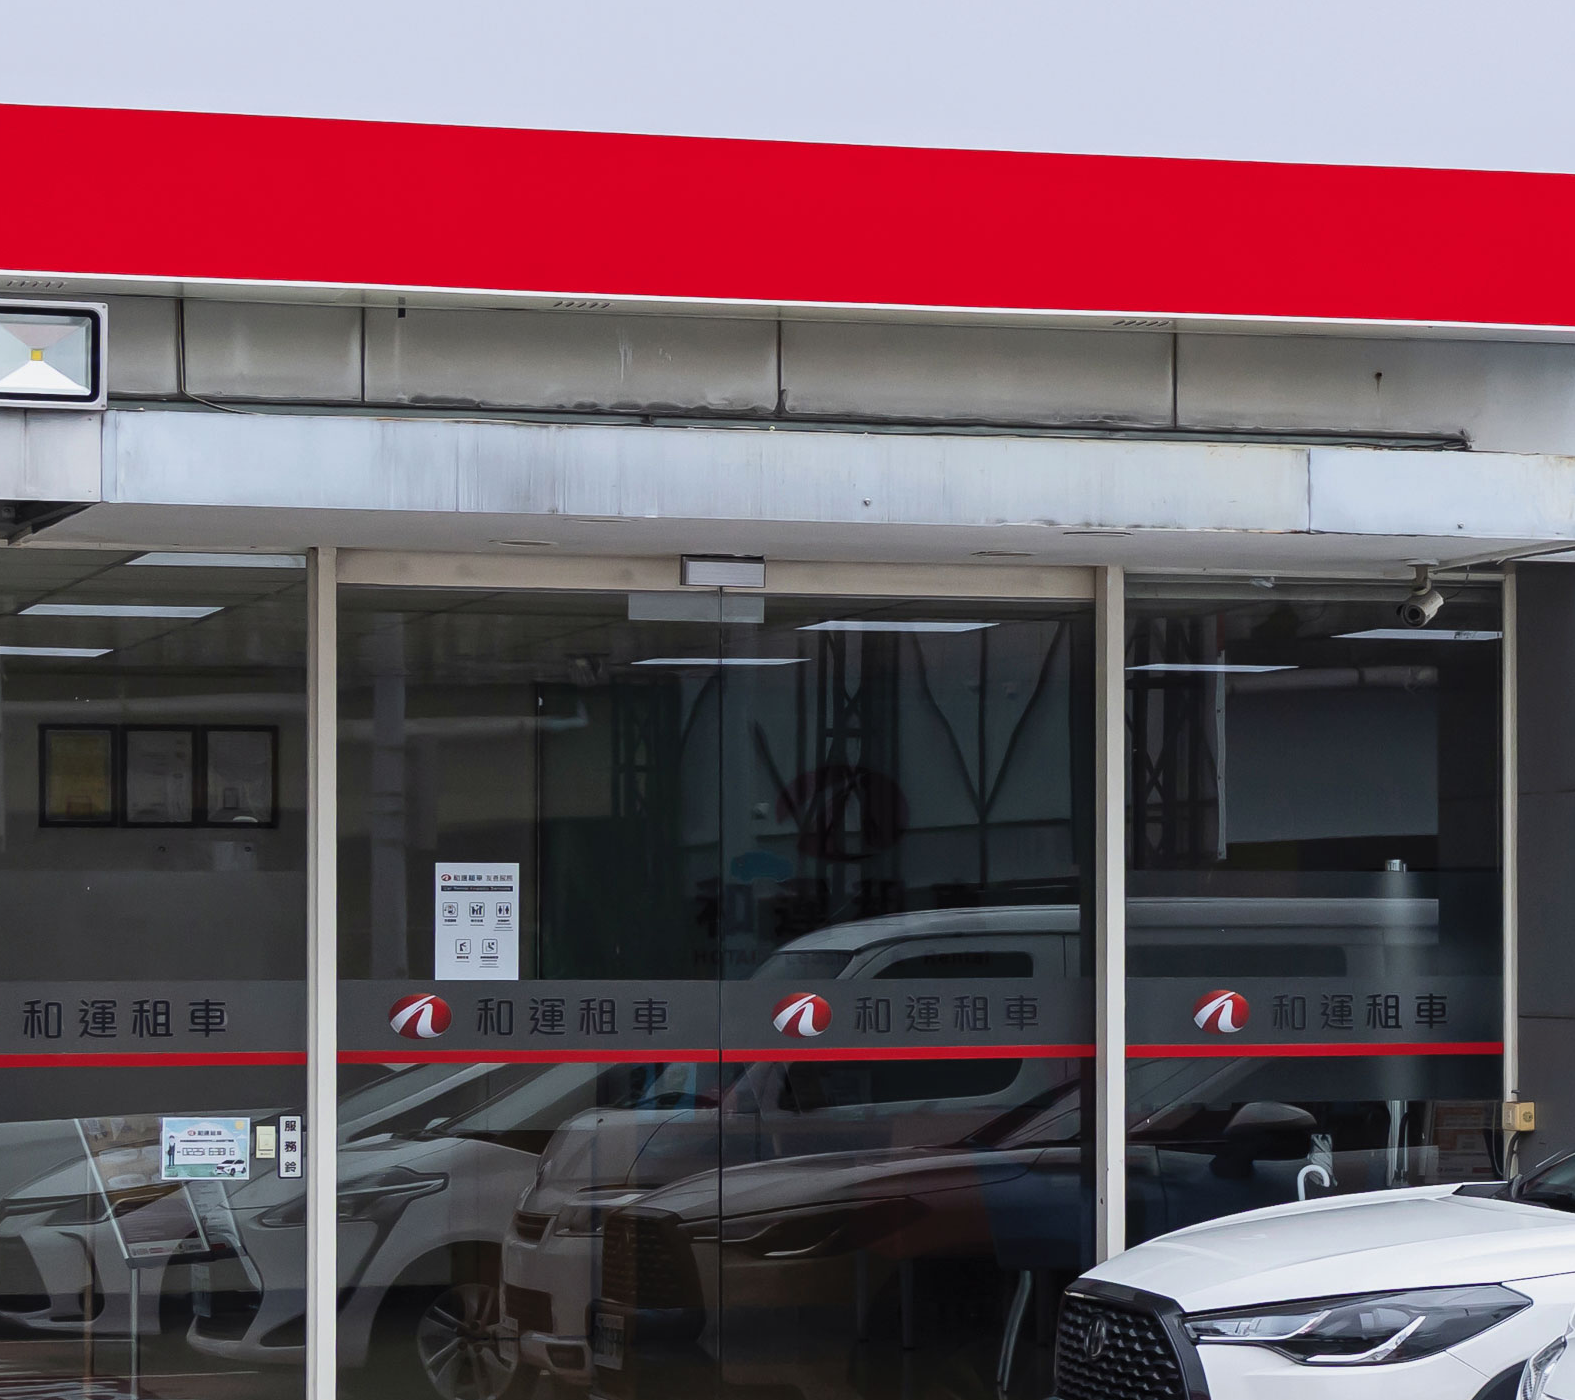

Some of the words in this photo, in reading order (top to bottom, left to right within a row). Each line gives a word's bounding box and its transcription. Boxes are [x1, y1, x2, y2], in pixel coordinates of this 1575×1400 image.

[24, 998, 227, 1039] 和運租車
[477, 997, 668, 1036] 和運租車
[855, 994, 1039, 1034] 和運租車
[1273, 993, 1448, 1031] 和運租車
[284, 1120, 297, 1173] 服務鈴
